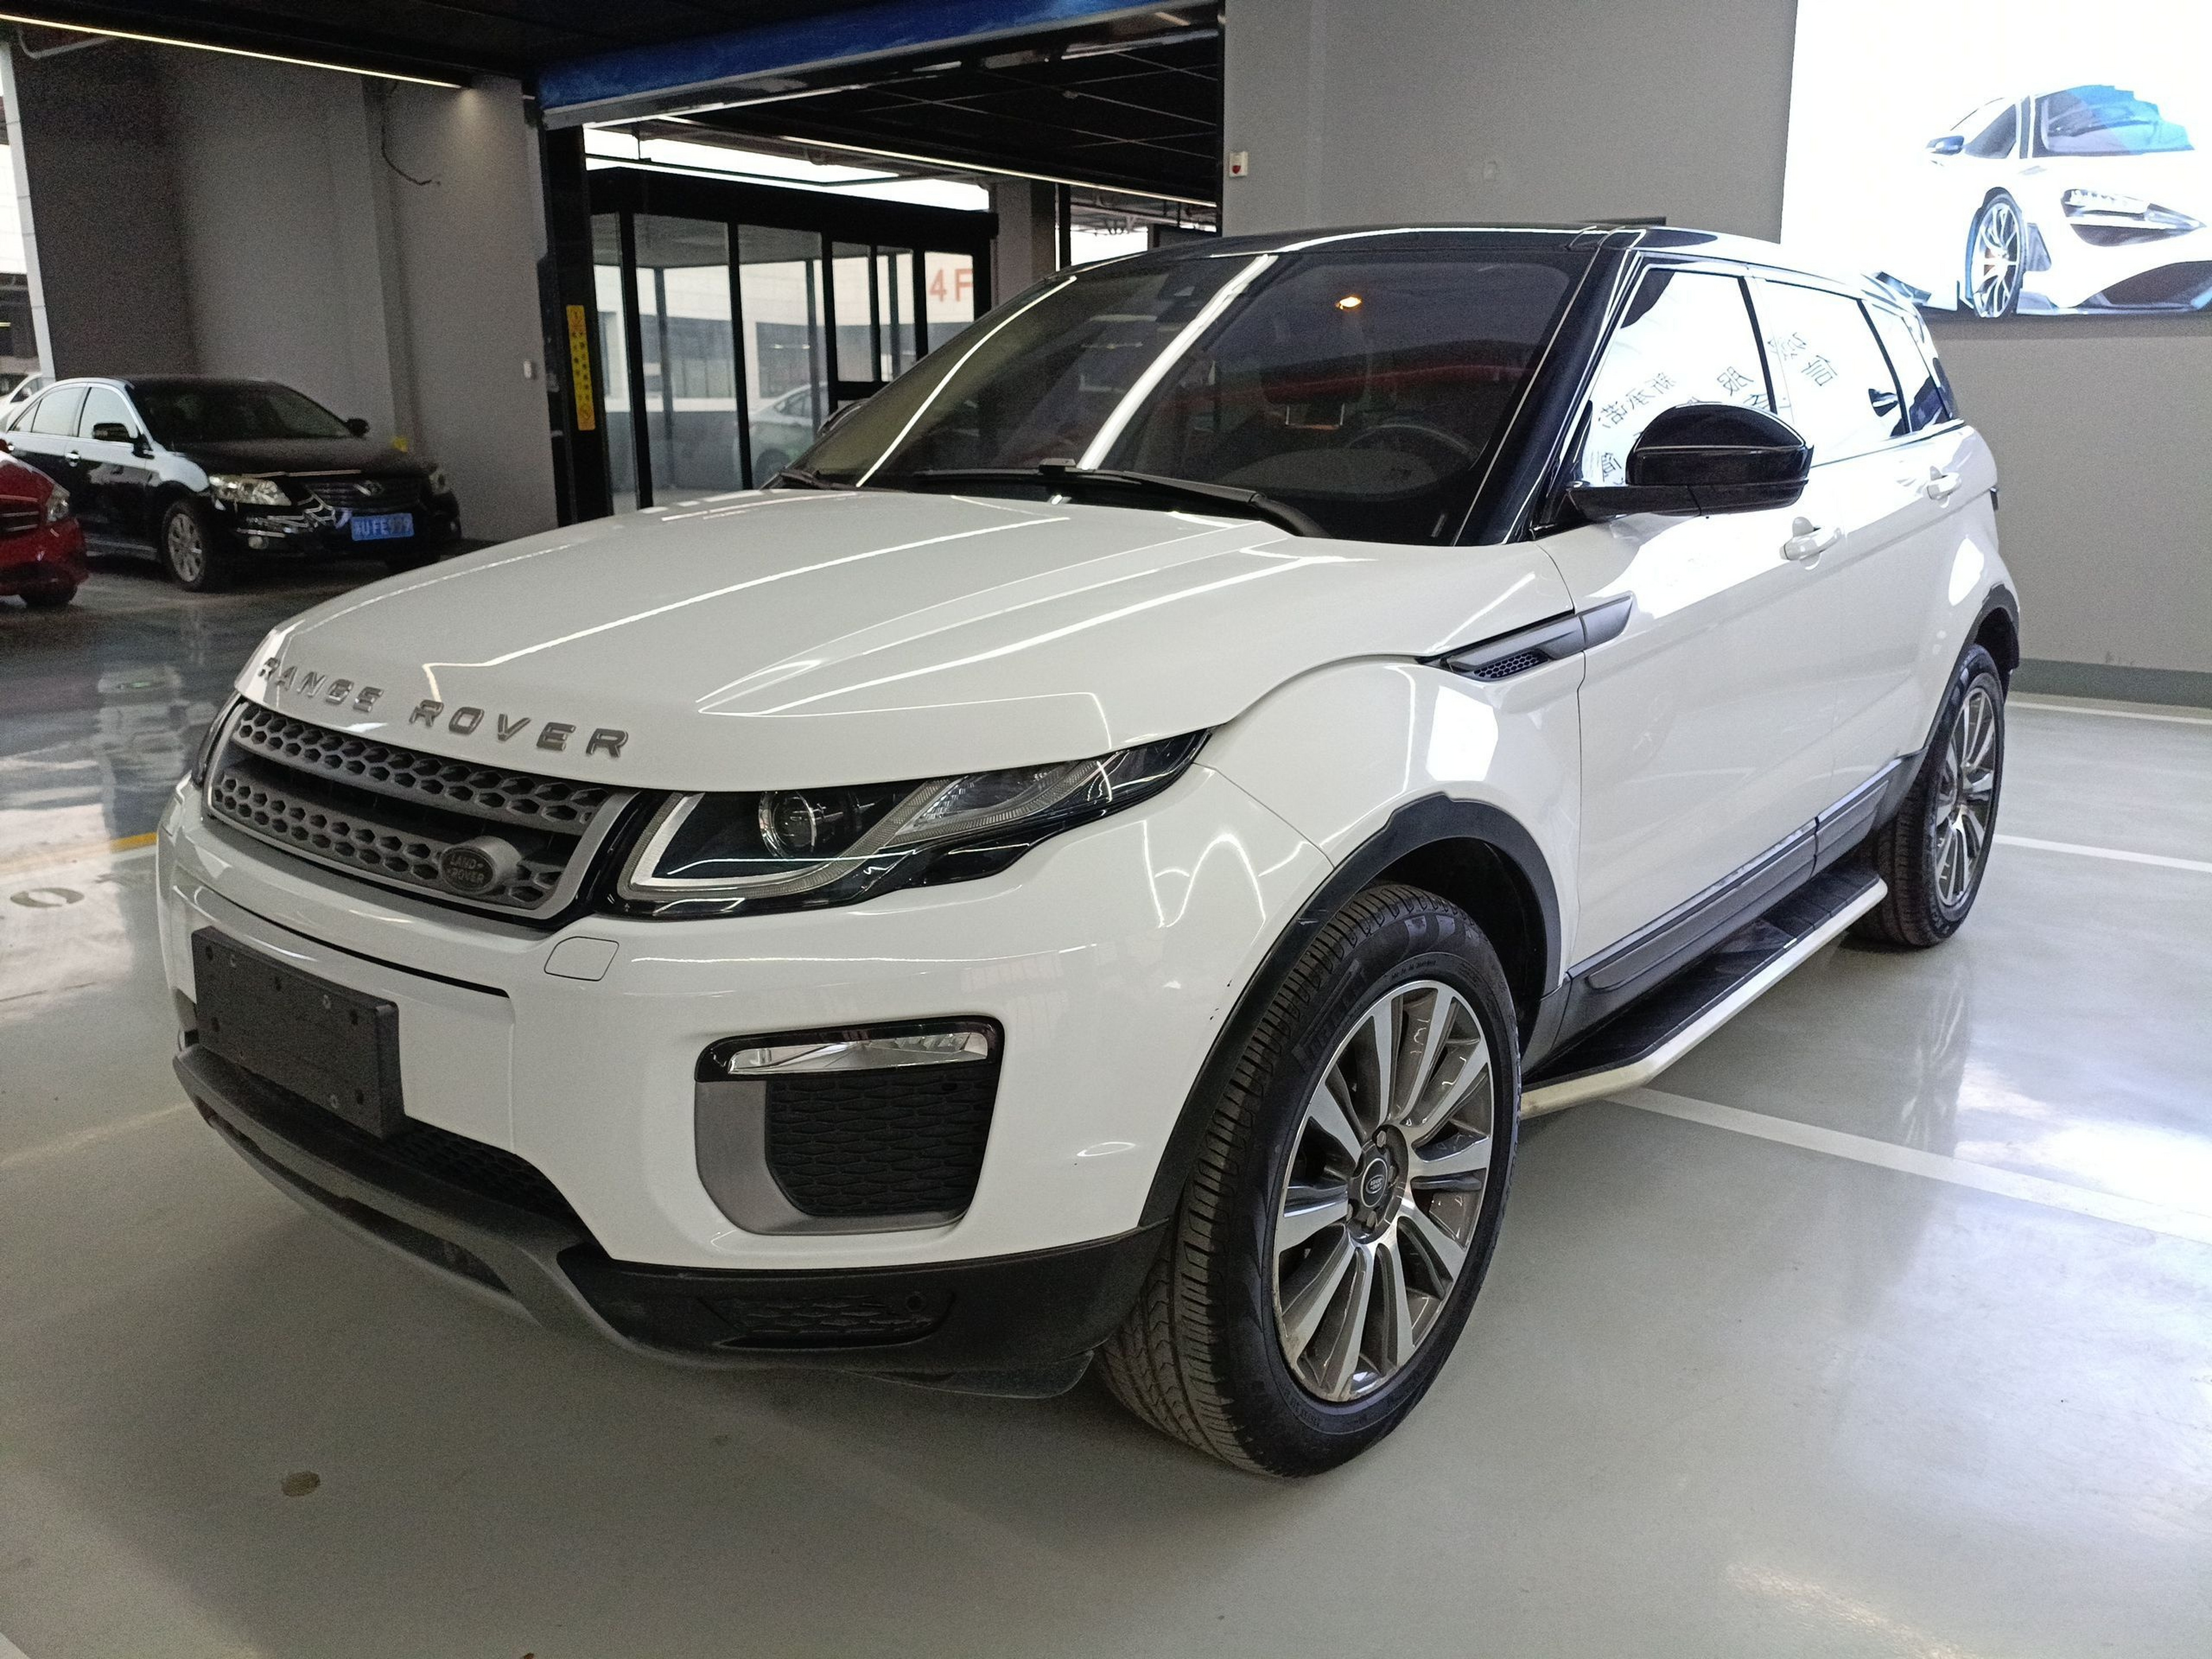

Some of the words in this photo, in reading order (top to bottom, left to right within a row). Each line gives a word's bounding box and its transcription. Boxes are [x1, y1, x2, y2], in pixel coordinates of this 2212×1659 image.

[929, 268, 974, 302] 4F
[258, 657, 384, 713] RANGE
[408, 699, 629, 758] ROVER
